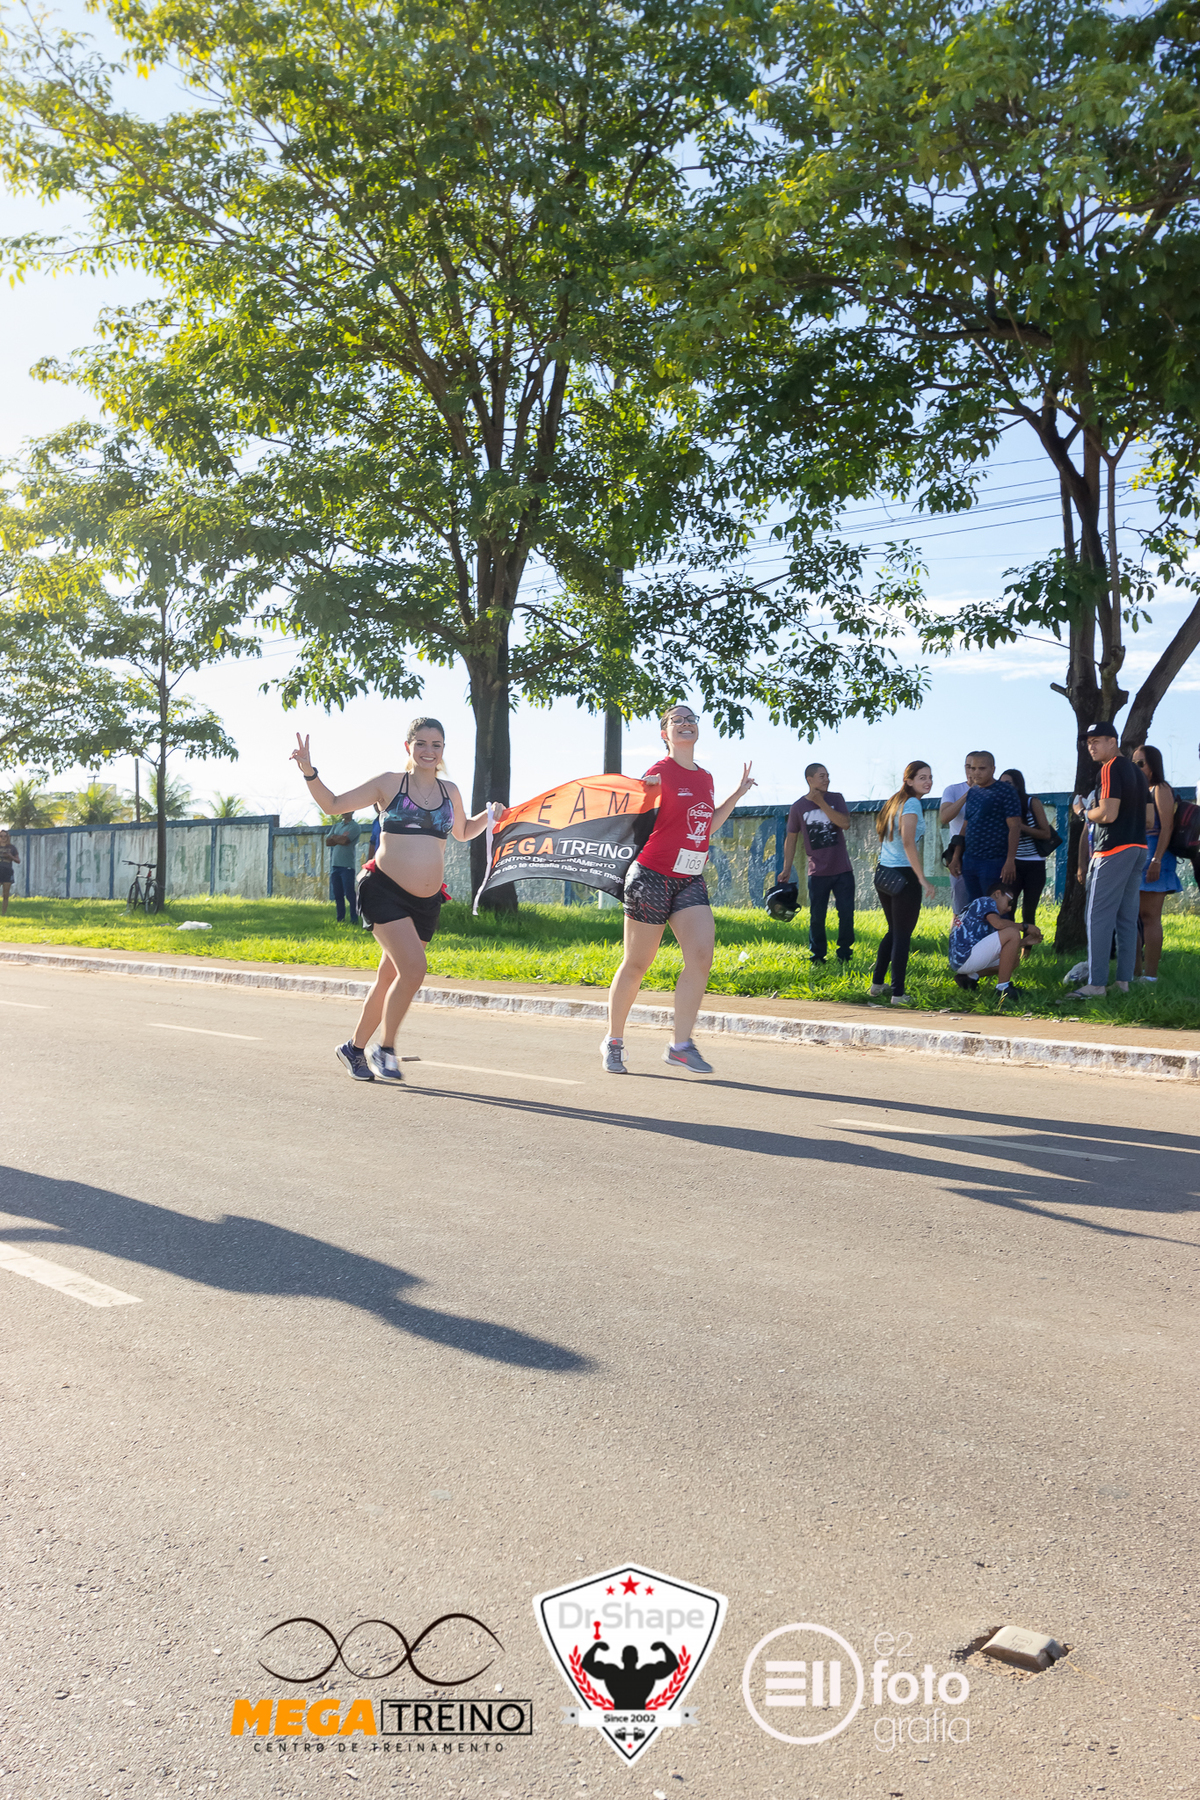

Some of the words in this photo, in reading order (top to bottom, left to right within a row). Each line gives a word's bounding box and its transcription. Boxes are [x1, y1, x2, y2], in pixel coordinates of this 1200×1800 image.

[560, 839, 634, 860] TREINO
[495, 855, 531, 868] CENTRO
[561, 864, 577, 872] não
[589, 868, 603, 876] faz
